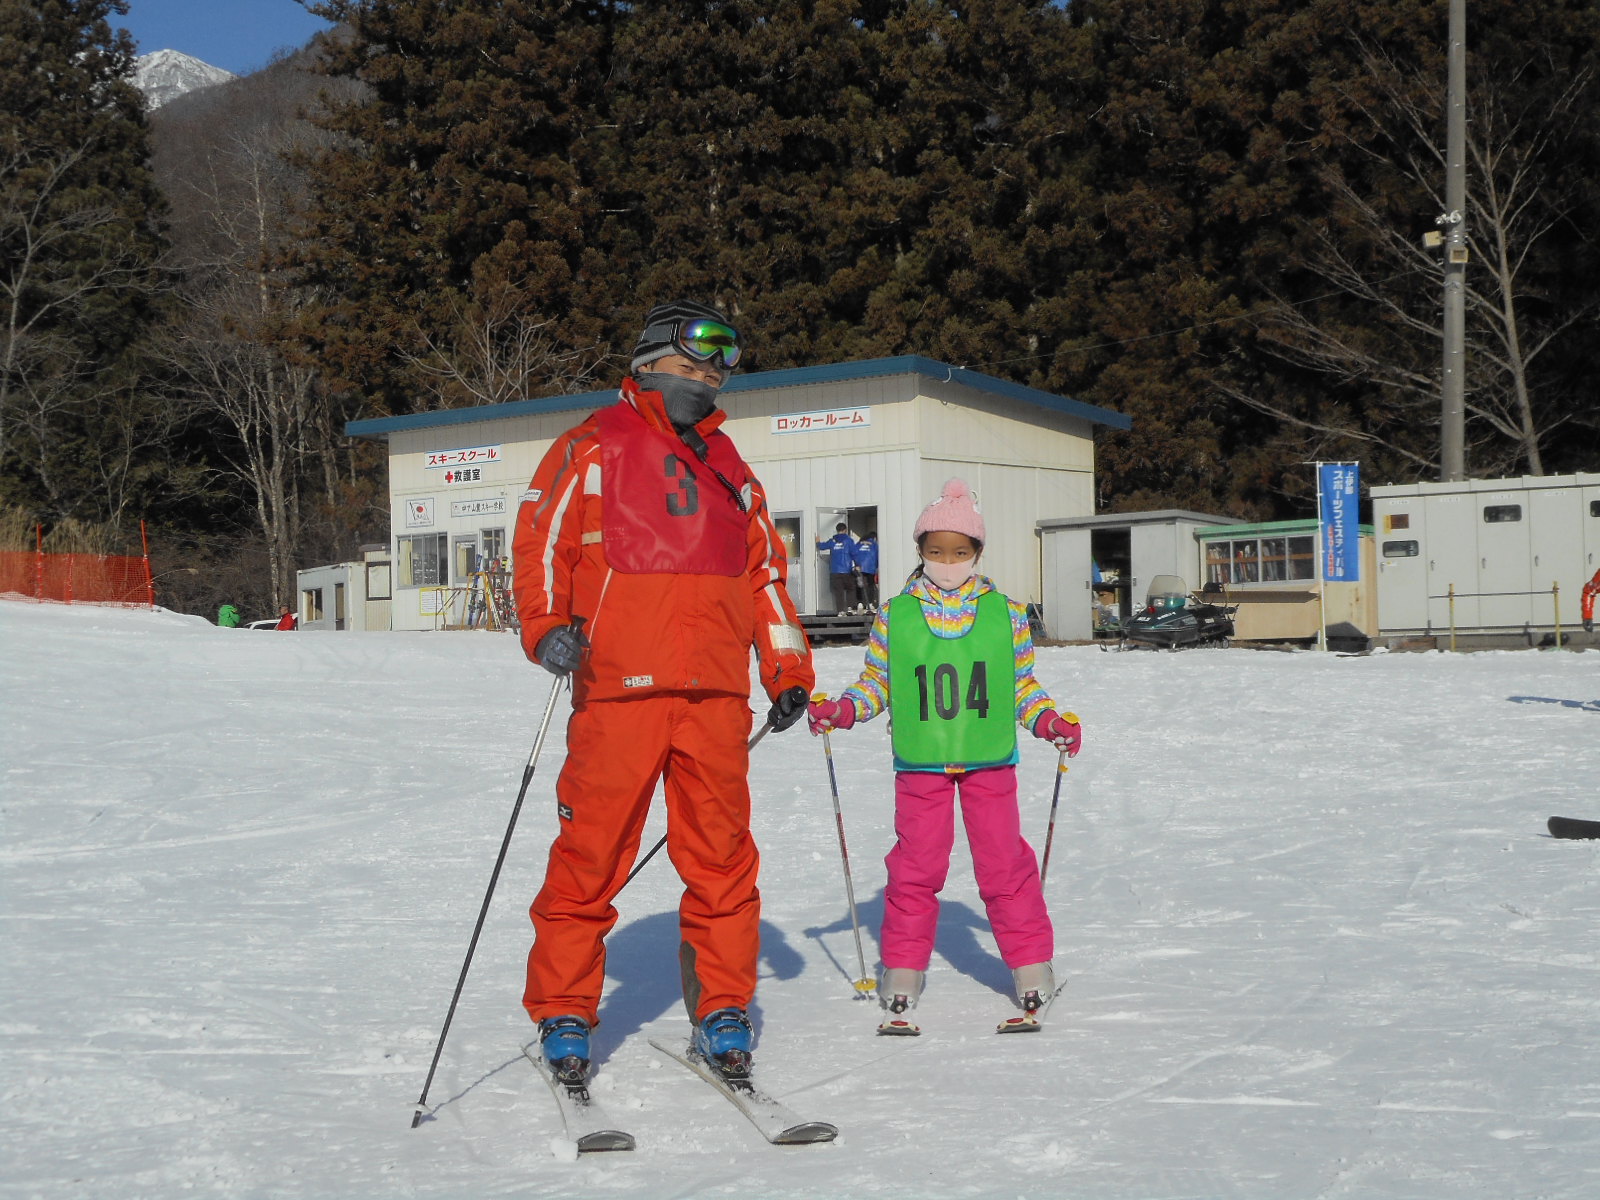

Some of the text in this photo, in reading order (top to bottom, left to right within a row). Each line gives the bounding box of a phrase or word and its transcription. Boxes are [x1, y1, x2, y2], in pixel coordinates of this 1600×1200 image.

[777, 411, 865, 430] ロッカールーム
[428, 448, 497, 466] スキースクール
[453, 468, 481, 483] 救護室
[664, 453, 698, 517] 3
[1332, 470, 1345, 577] スポーツフェスティバル
[914, 660, 990, 722] 104
